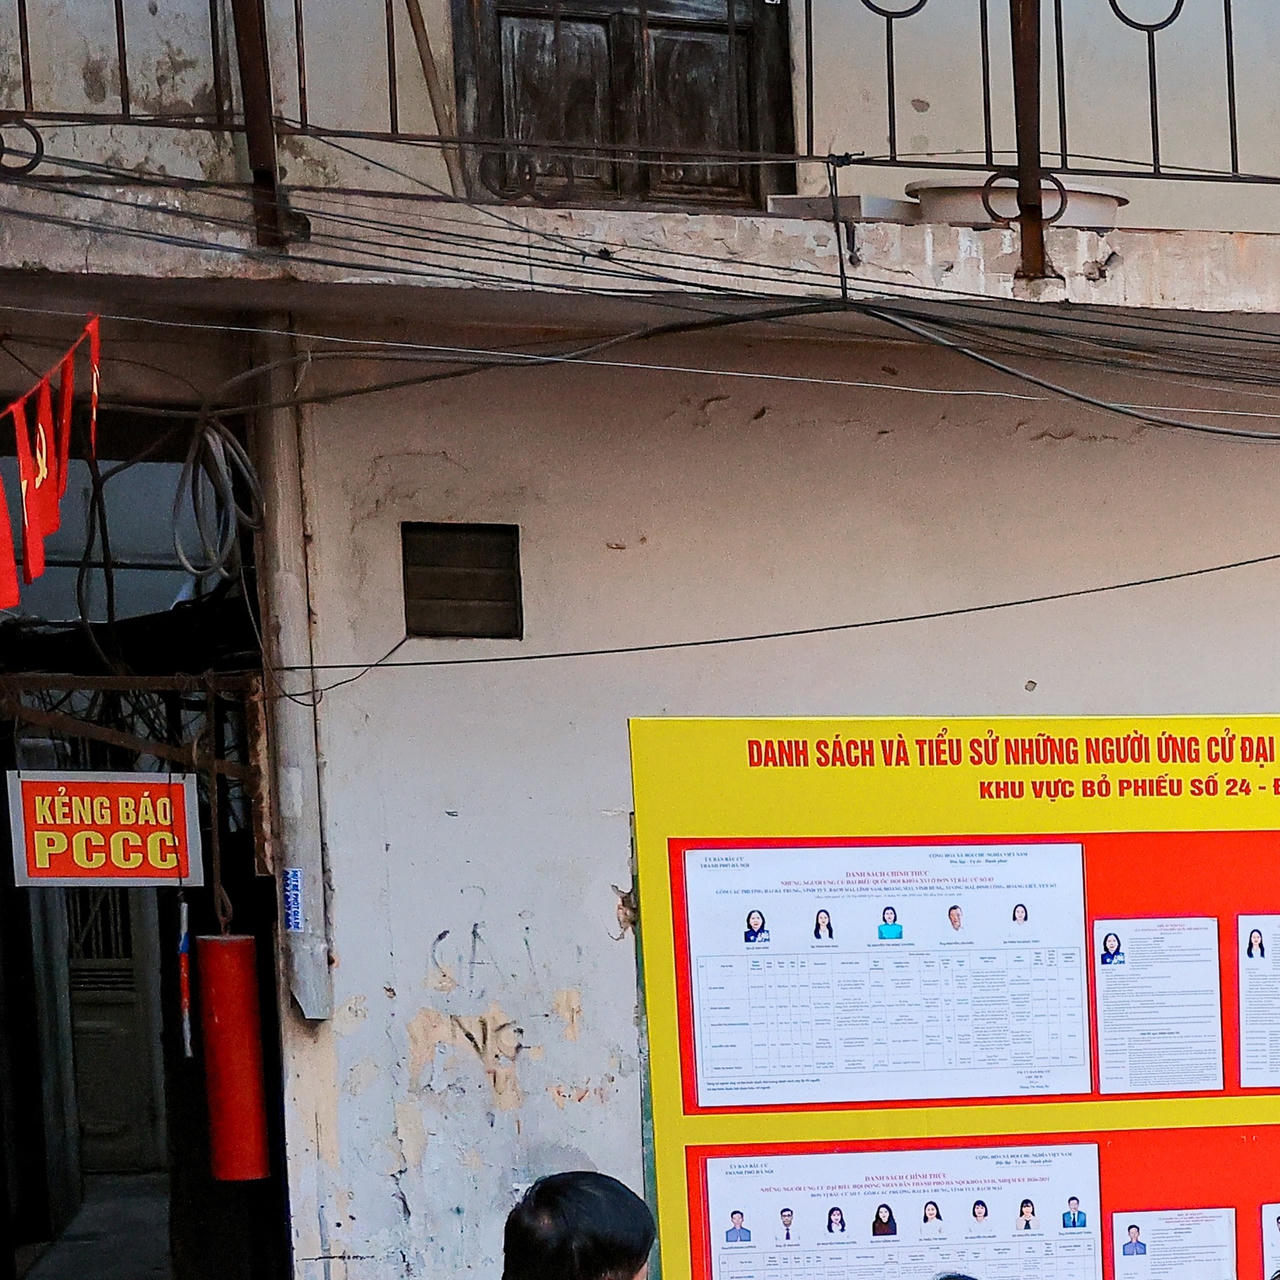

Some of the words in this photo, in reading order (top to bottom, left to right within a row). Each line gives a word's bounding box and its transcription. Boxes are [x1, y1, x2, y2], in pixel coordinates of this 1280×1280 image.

[748, 740, 807, 767] DANH
[816, 734, 875, 767] SÁCH
[881, 734, 910, 767] VÀ
[916, 728, 961, 766] TIỂU
[969, 729, 999, 766] SỬ
[1005, 733, 1079, 765] NHỮNG
[1085, 730, 1150, 764] NGƯỜI
[1157, 731, 1200, 763] ỨNG
[1207, 728, 1236, 763] CỬ
[1240, 736, 1275, 768] ĐẠI
[35, 786, 111, 826] KẺNG
[118, 790, 172, 826] BÁO
[980, 780, 1024, 799] KHU
[1031, 779, 1075, 802] VỰC
[1082, 774, 1111, 798] BỎ
[1118, 772, 1183, 797] PHIẾU
[1190, 772, 1218, 796] SỐ
[1225, 777, 1251, 796] 24
[33, 830, 180, 870] PCCC
